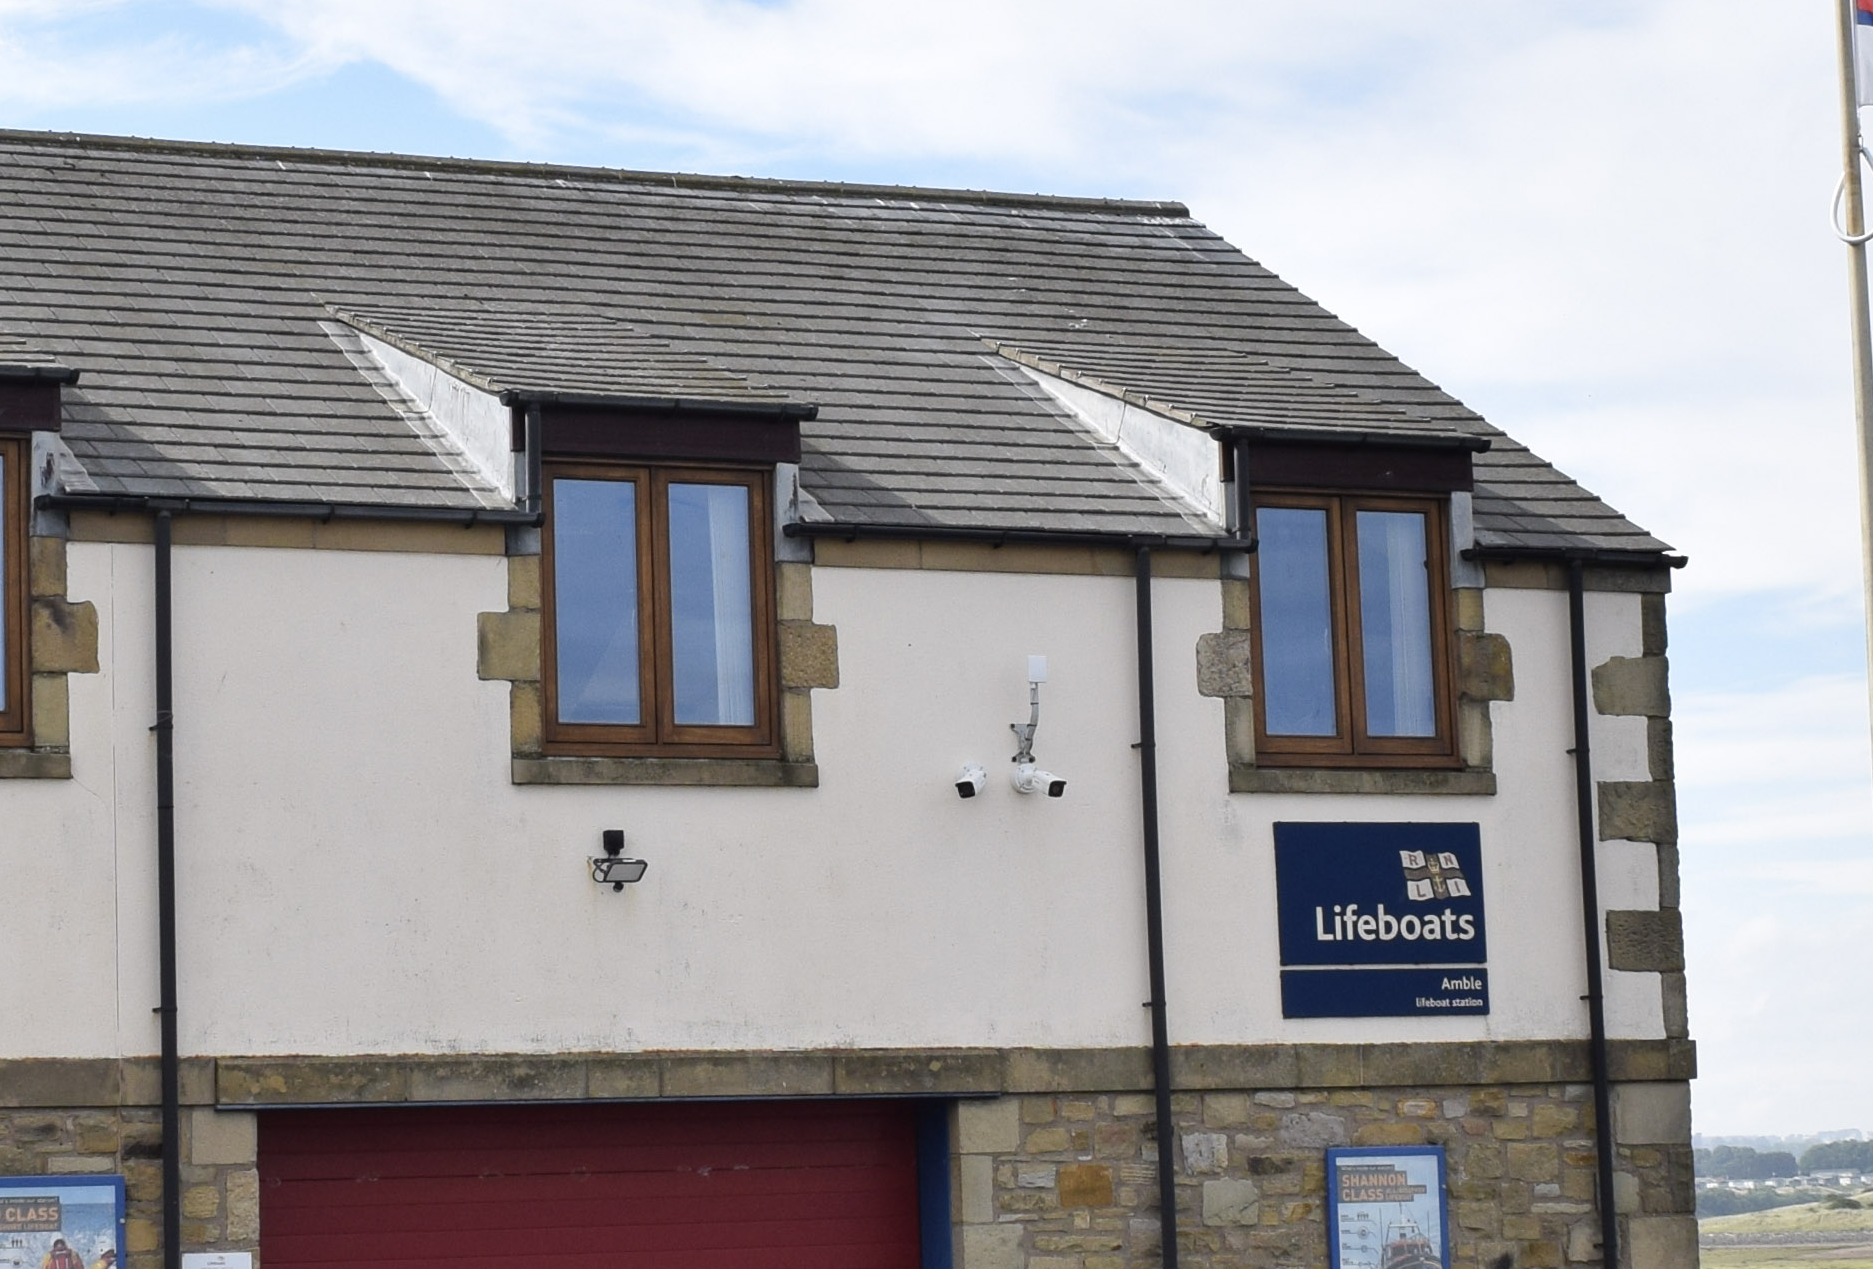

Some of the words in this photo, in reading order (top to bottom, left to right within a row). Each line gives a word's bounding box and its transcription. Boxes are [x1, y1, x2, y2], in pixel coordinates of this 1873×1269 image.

[1409, 854, 1418, 865] R
[1444, 854, 1453, 865] N
[1416, 884, 1426, 898] L
[1316, 904, 1475, 941] Lifeboats
[1442, 976, 1482, 990] Amble
[1416, 997, 1450, 1007] lifeboat
[1452, 997, 1483, 1007] station
[1342, 1174, 1405, 1186] SHANNON
[1343, 1189, 1384, 1201] CLASS
[6, 1208, 58, 1221] CLASS
